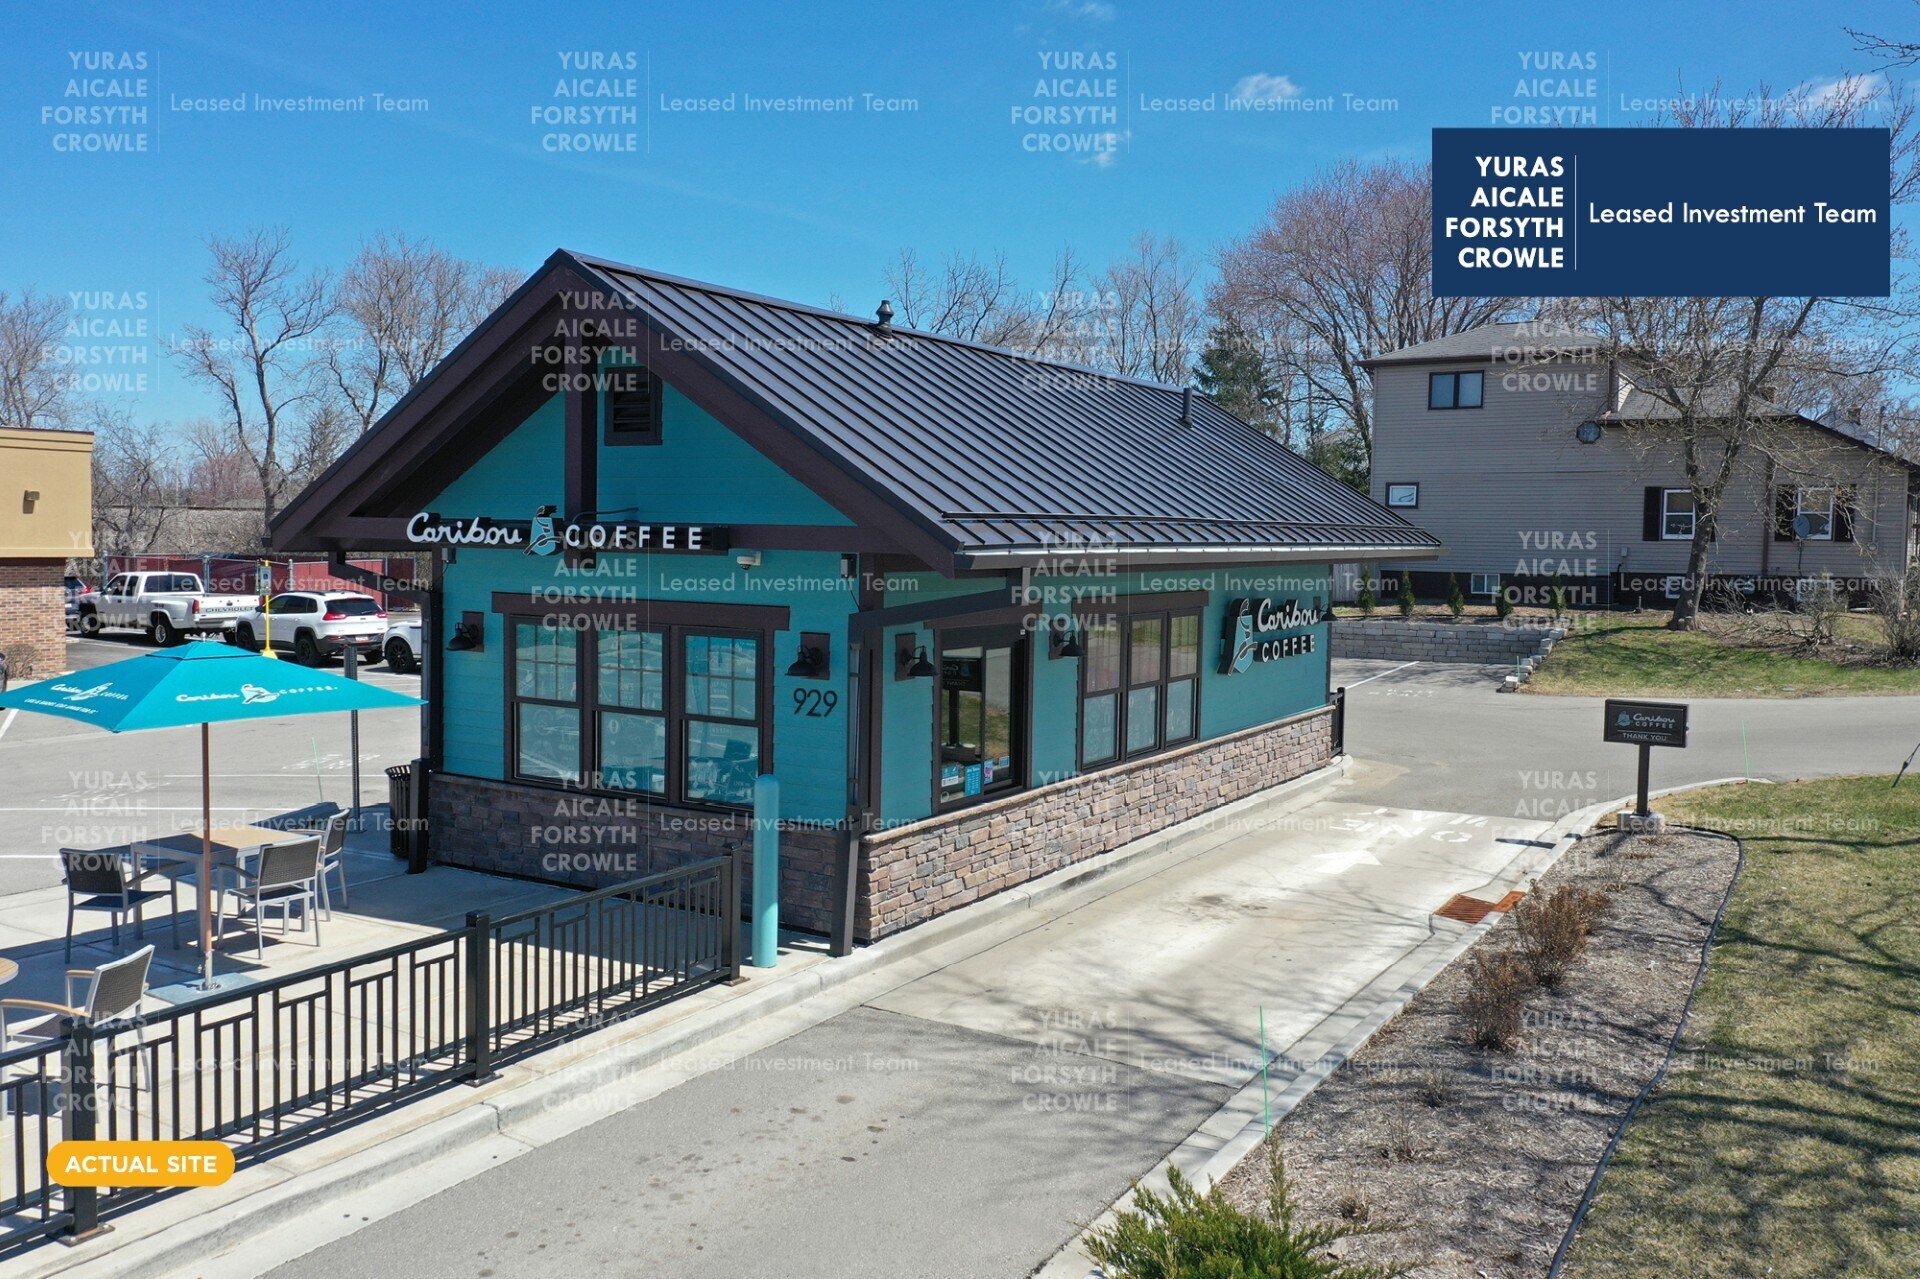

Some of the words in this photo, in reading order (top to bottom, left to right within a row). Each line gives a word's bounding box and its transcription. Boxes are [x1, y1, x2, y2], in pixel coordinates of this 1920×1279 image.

[406, 511, 523, 546] Caribou
[565, 524, 702, 550] COFFEE
[1257, 597, 1319, 633] Caribou
[1261, 634, 1316, 663] COFFEE
[793, 687, 838, 717] 929
[1632, 713, 1676, 724] Caribou
[1635, 721, 1674, 729] COFFEE
[1622, 732, 1649, 741] THANK
[1650, 734, 1667, 742] YOU
